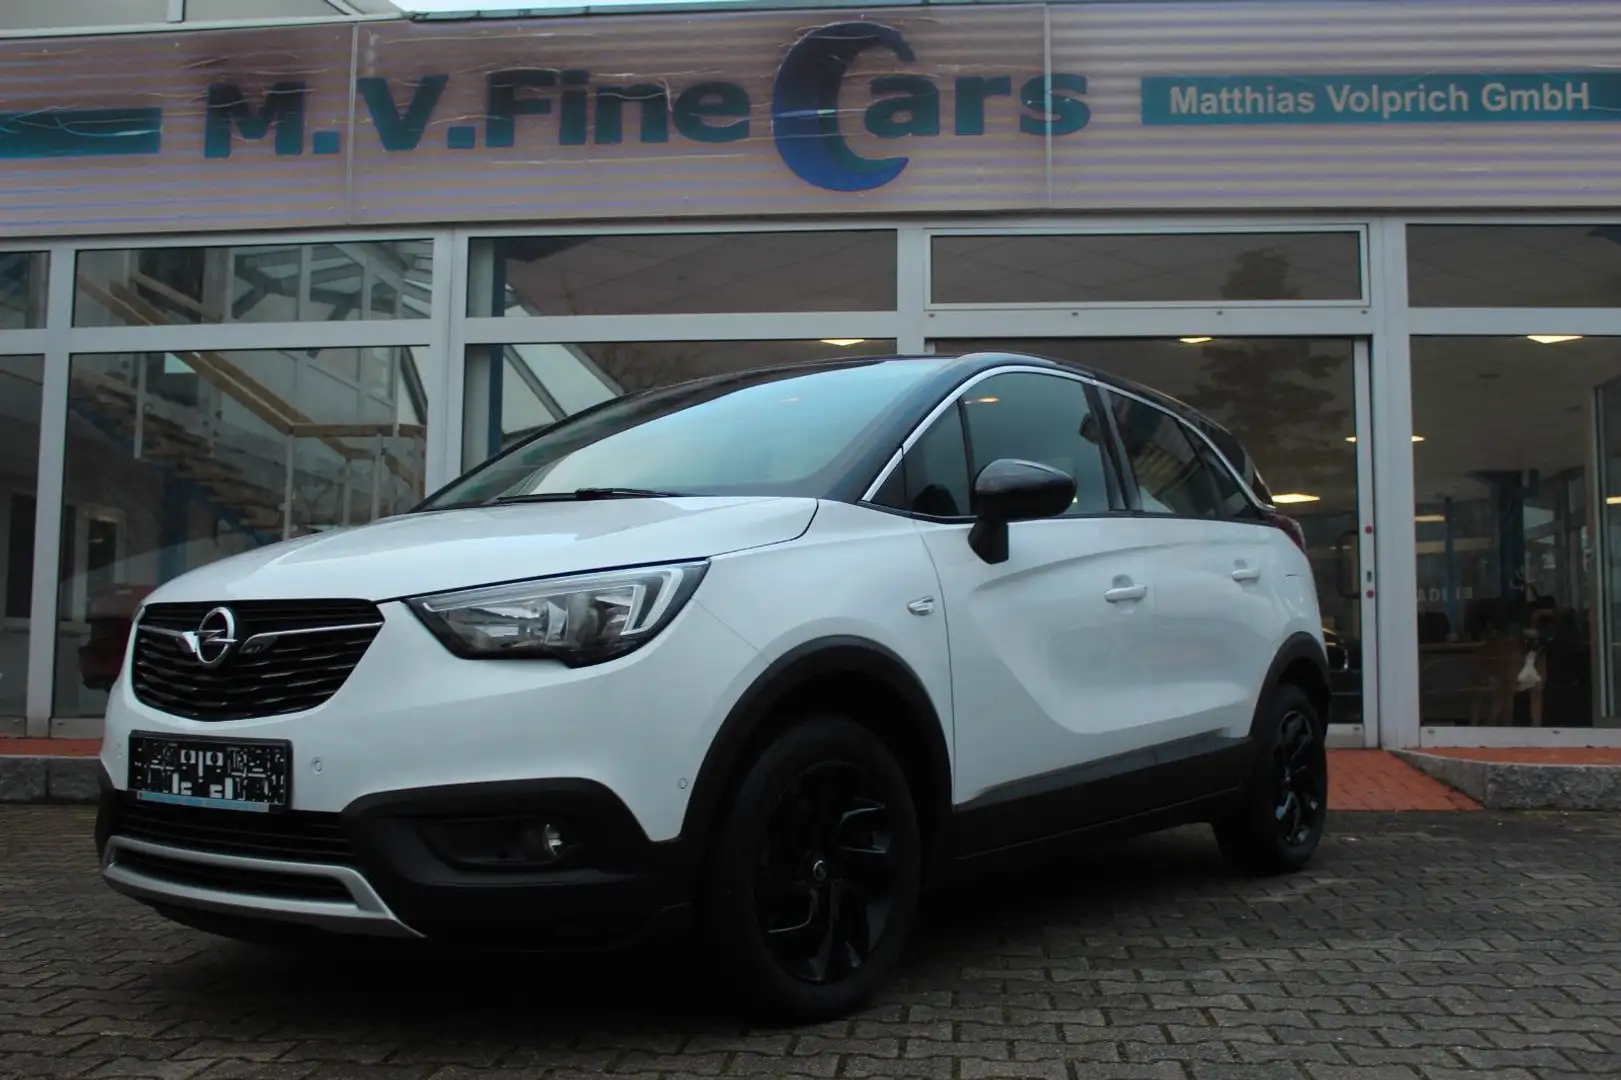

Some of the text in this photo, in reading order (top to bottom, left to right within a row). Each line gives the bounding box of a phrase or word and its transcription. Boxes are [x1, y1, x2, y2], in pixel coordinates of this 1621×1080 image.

[1170, 81, 1590, 120] Matthias Volprich GmbH
